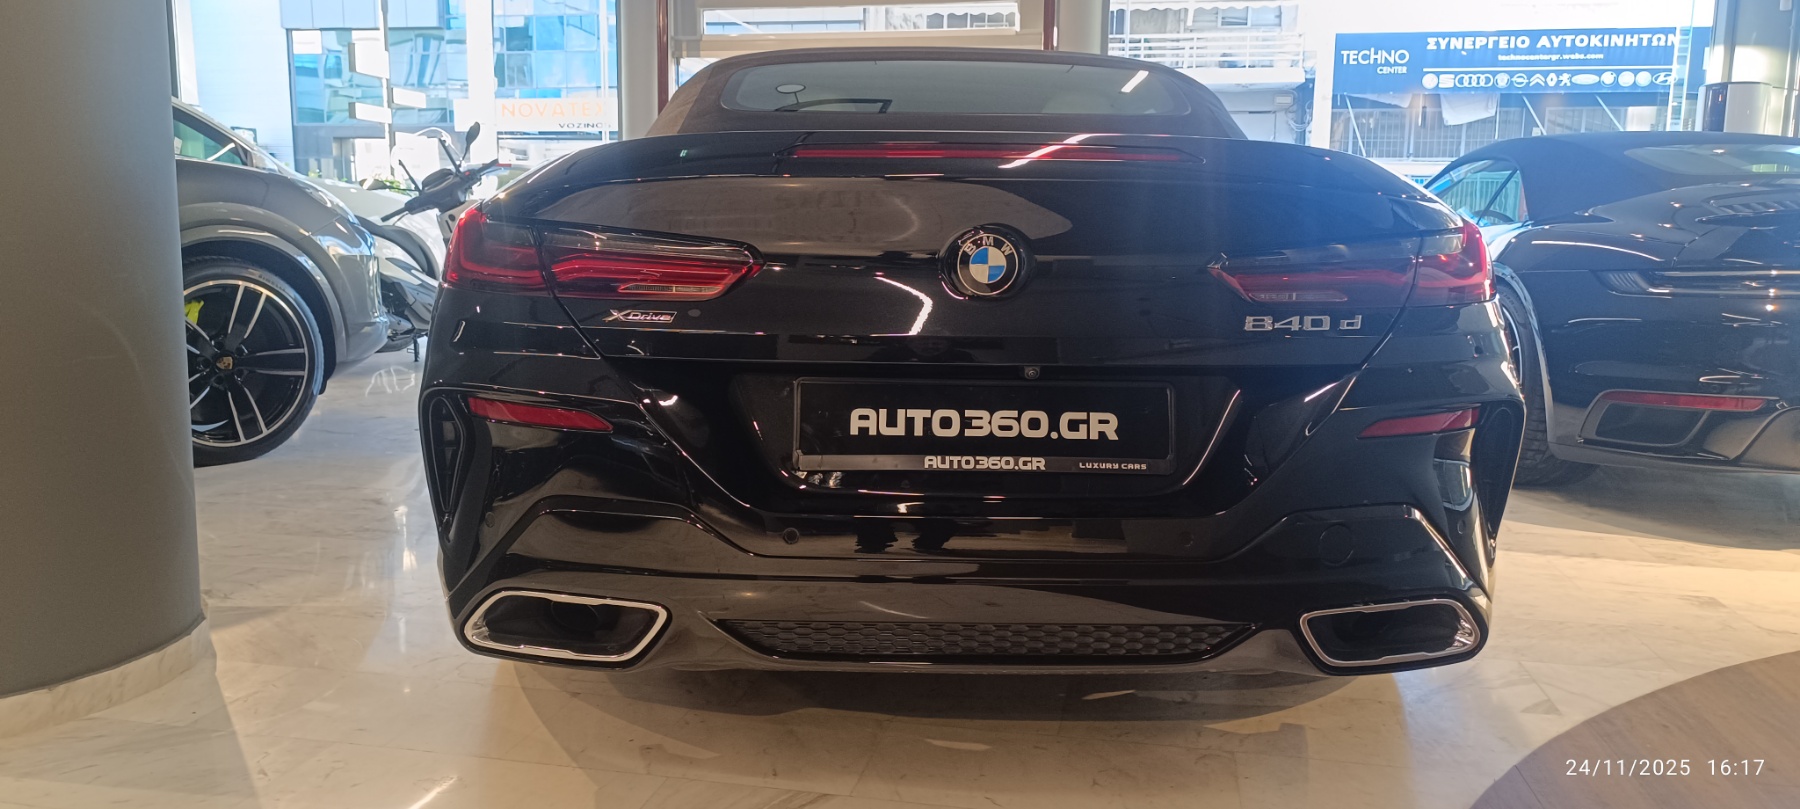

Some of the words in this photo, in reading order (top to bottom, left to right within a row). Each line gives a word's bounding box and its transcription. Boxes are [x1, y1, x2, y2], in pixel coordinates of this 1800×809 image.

[1426, 35, 1530, 50] ΣΥΝΕΡΓΕΙΟ
[1341, 47, 1410, 65] TECHNO
[1376, 66, 1408, 75] CENTER
[963, 236, 1013, 256] BMW
[1244, 315, 1331, 331] 840
[1338, 315, 1362, 330] d
[850, 408, 1119, 441] AUTO360.GR
[924, 455, 1046, 471] AUTO360.GR
